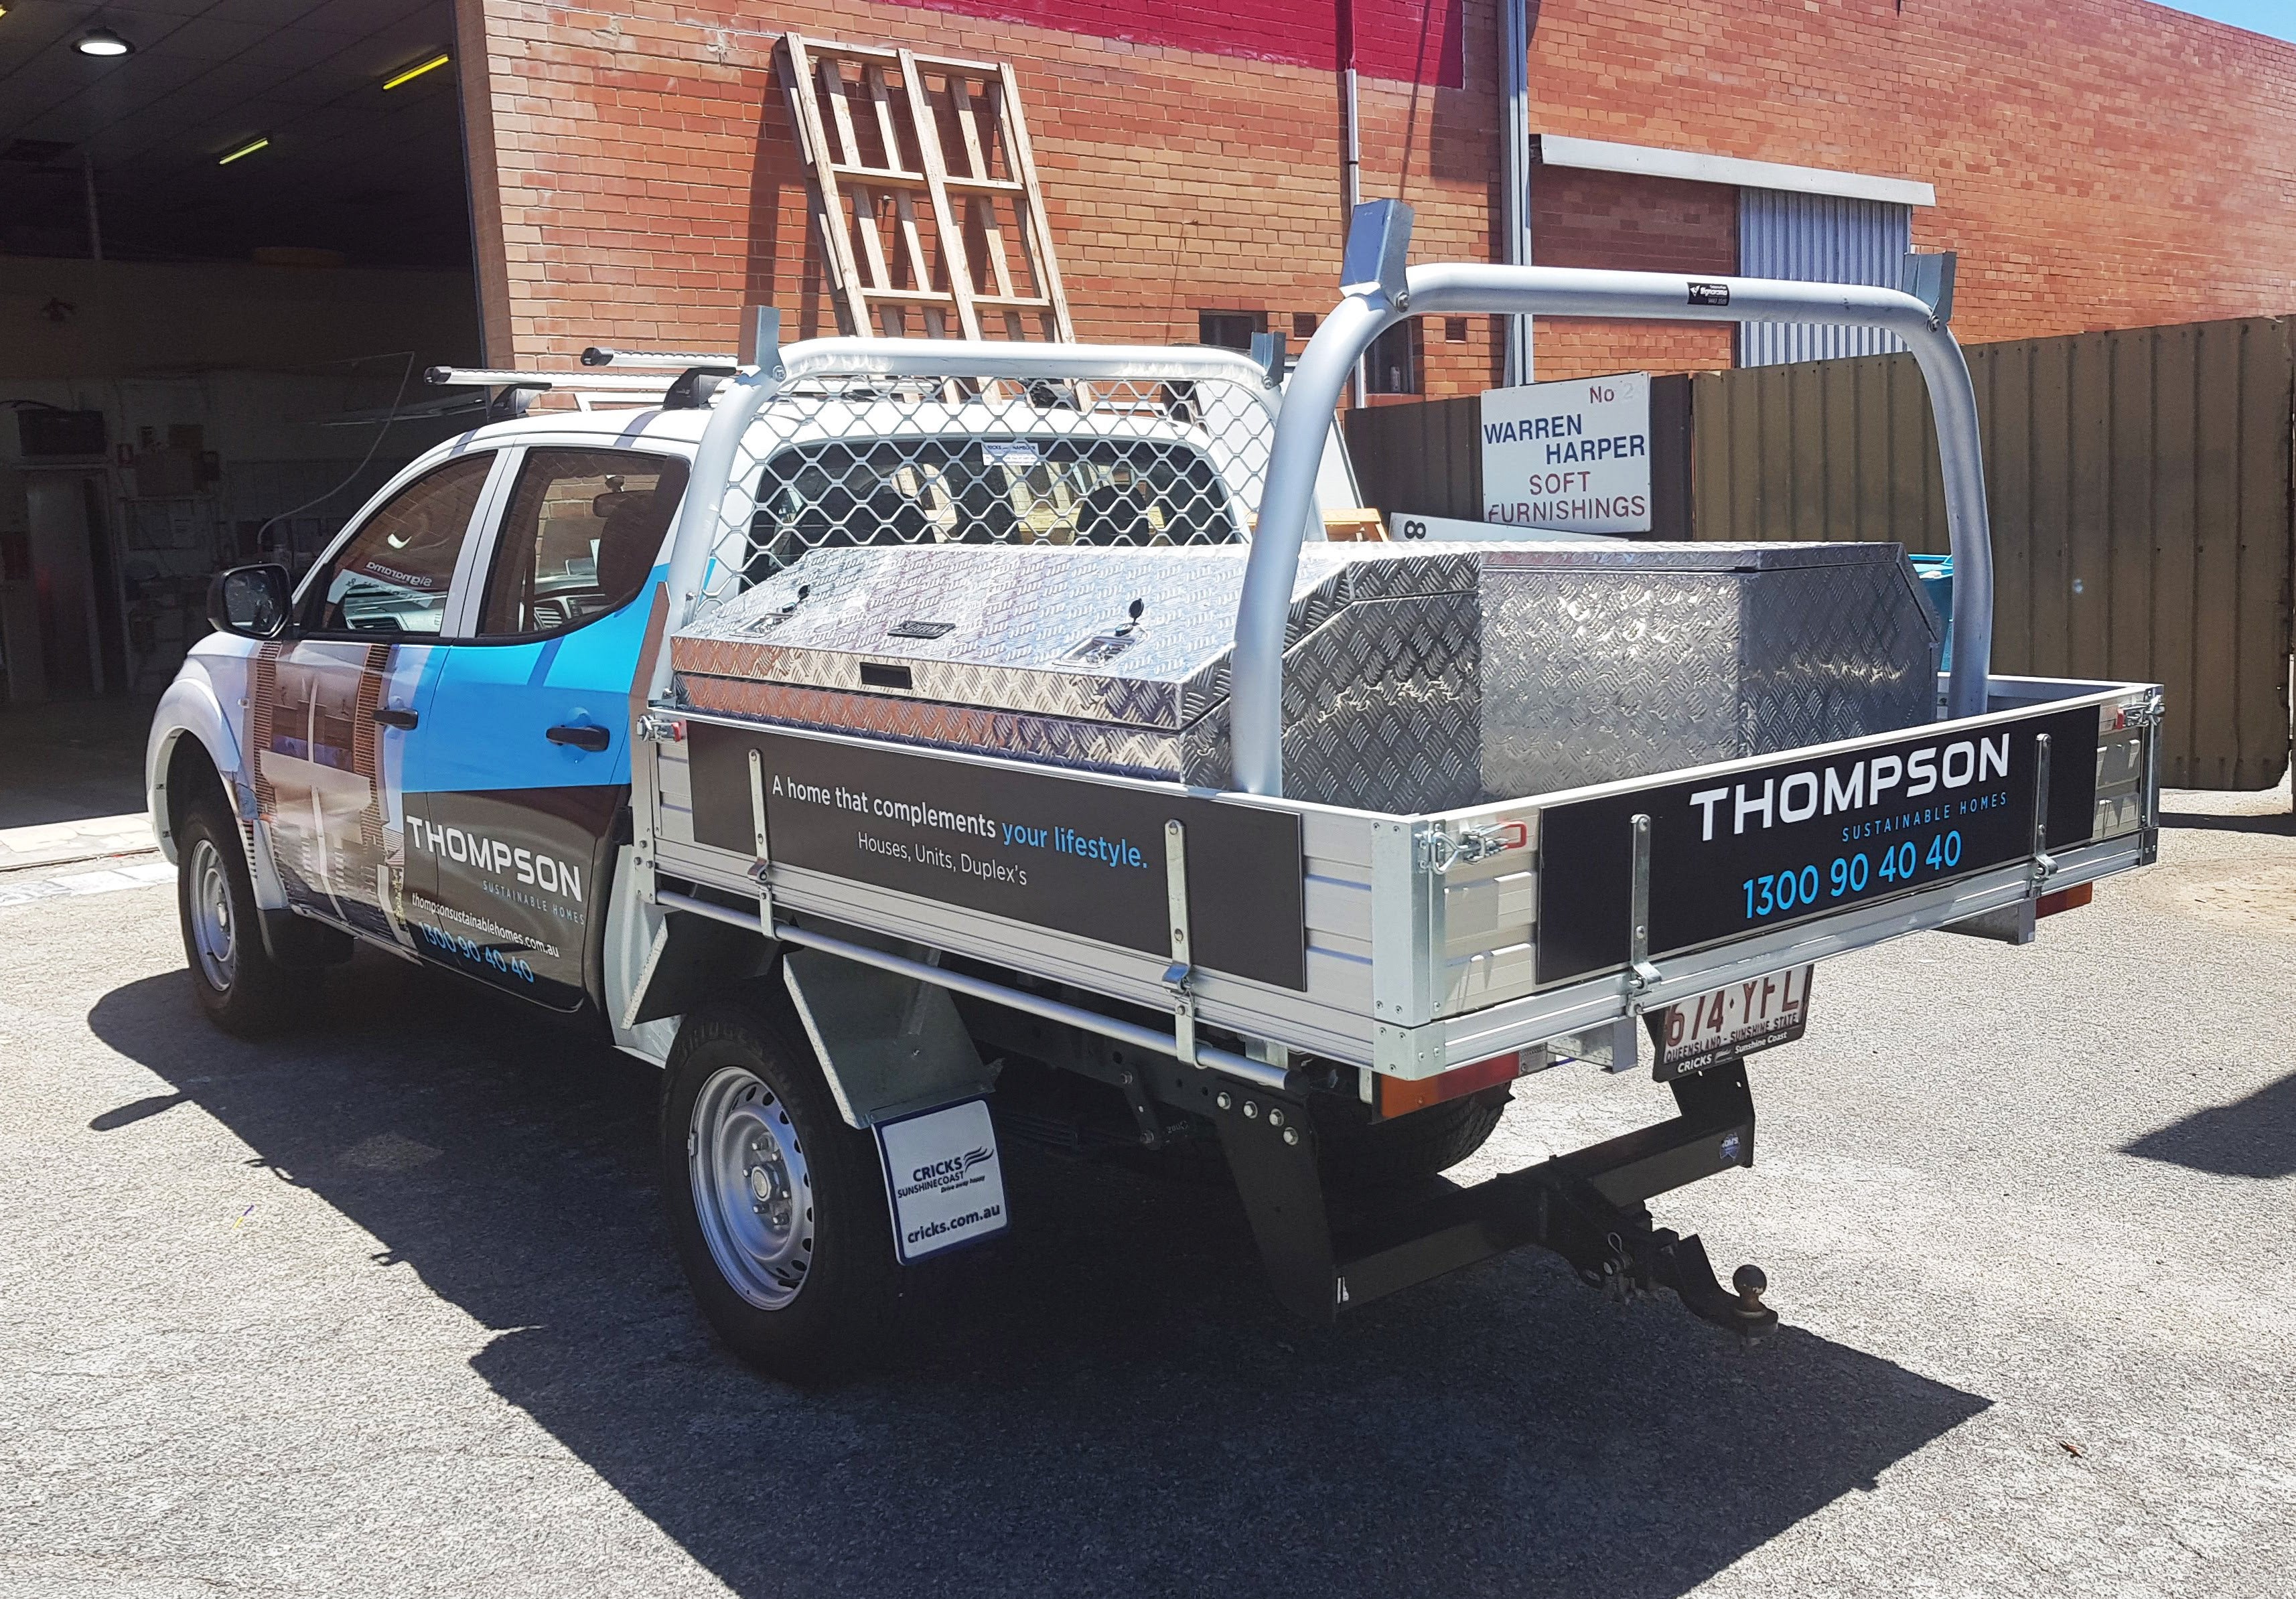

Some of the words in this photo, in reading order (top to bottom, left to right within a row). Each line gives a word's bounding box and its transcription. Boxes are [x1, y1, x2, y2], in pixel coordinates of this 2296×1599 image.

[1589, 385, 1615, 404] No
[1484, 413, 1582, 445] WARREN
[1546, 435, 1645, 465] HARPER
[1529, 471, 1591, 496] SOFT
[1488, 496, 1645, 523] FURNISHINGS
[1689, 733, 2010, 842] THOMPSON
[772, 775, 784, 796] A
[787, 781, 831, 806] home
[835, 786, 869, 813] that
[873, 797, 997, 839] complements
[1002, 820, 1048, 848] your
[1054, 825, 1149, 869] lifestyle.
[1842, 804, 1950, 842] SUSTAINABLE
[1959, 791, 2007, 816] HOMES
[406, 814, 583, 903] THOMPSON
[858, 831, 912, 862] Houses,
[915, 843, 956, 872] Units,
[960, 853, 1027, 887] Duplex's
[1742, 864, 1819, 919] 1300
[1829, 852, 1869, 898] 90
[1878, 840, 1917, 883] 40
[1925, 830, 1962, 871] 40
[411, 891, 561, 959] thompsonsustainablehomes.com.au
[482, 879, 548, 913] SUSTAINABLE
[553, 905, 585, 926] HOMES
[419, 921, 457, 954] 1300
[457, 935, 482, 964] 90
[484, 945, 508, 973] 40
[511, 956, 534, 984] 40
[1666, 1035, 1722, 1063] QUEENSLAND
[1730, 1020, 1770, 1043] SUNSHINE
[1774, 1012, 1798, 1030] STATE
[1677, 1053, 1713, 1073] CRICKS
[1734, 1039, 1767, 1055] Sunshine
[1767, 1031, 1788, 1044] Coast
[898, 1170, 964, 1199] SUNSHINECOAST
[912, 1156, 962, 1183] CRICKS
[907, 1205, 1001, 1243] cricks.com.au
